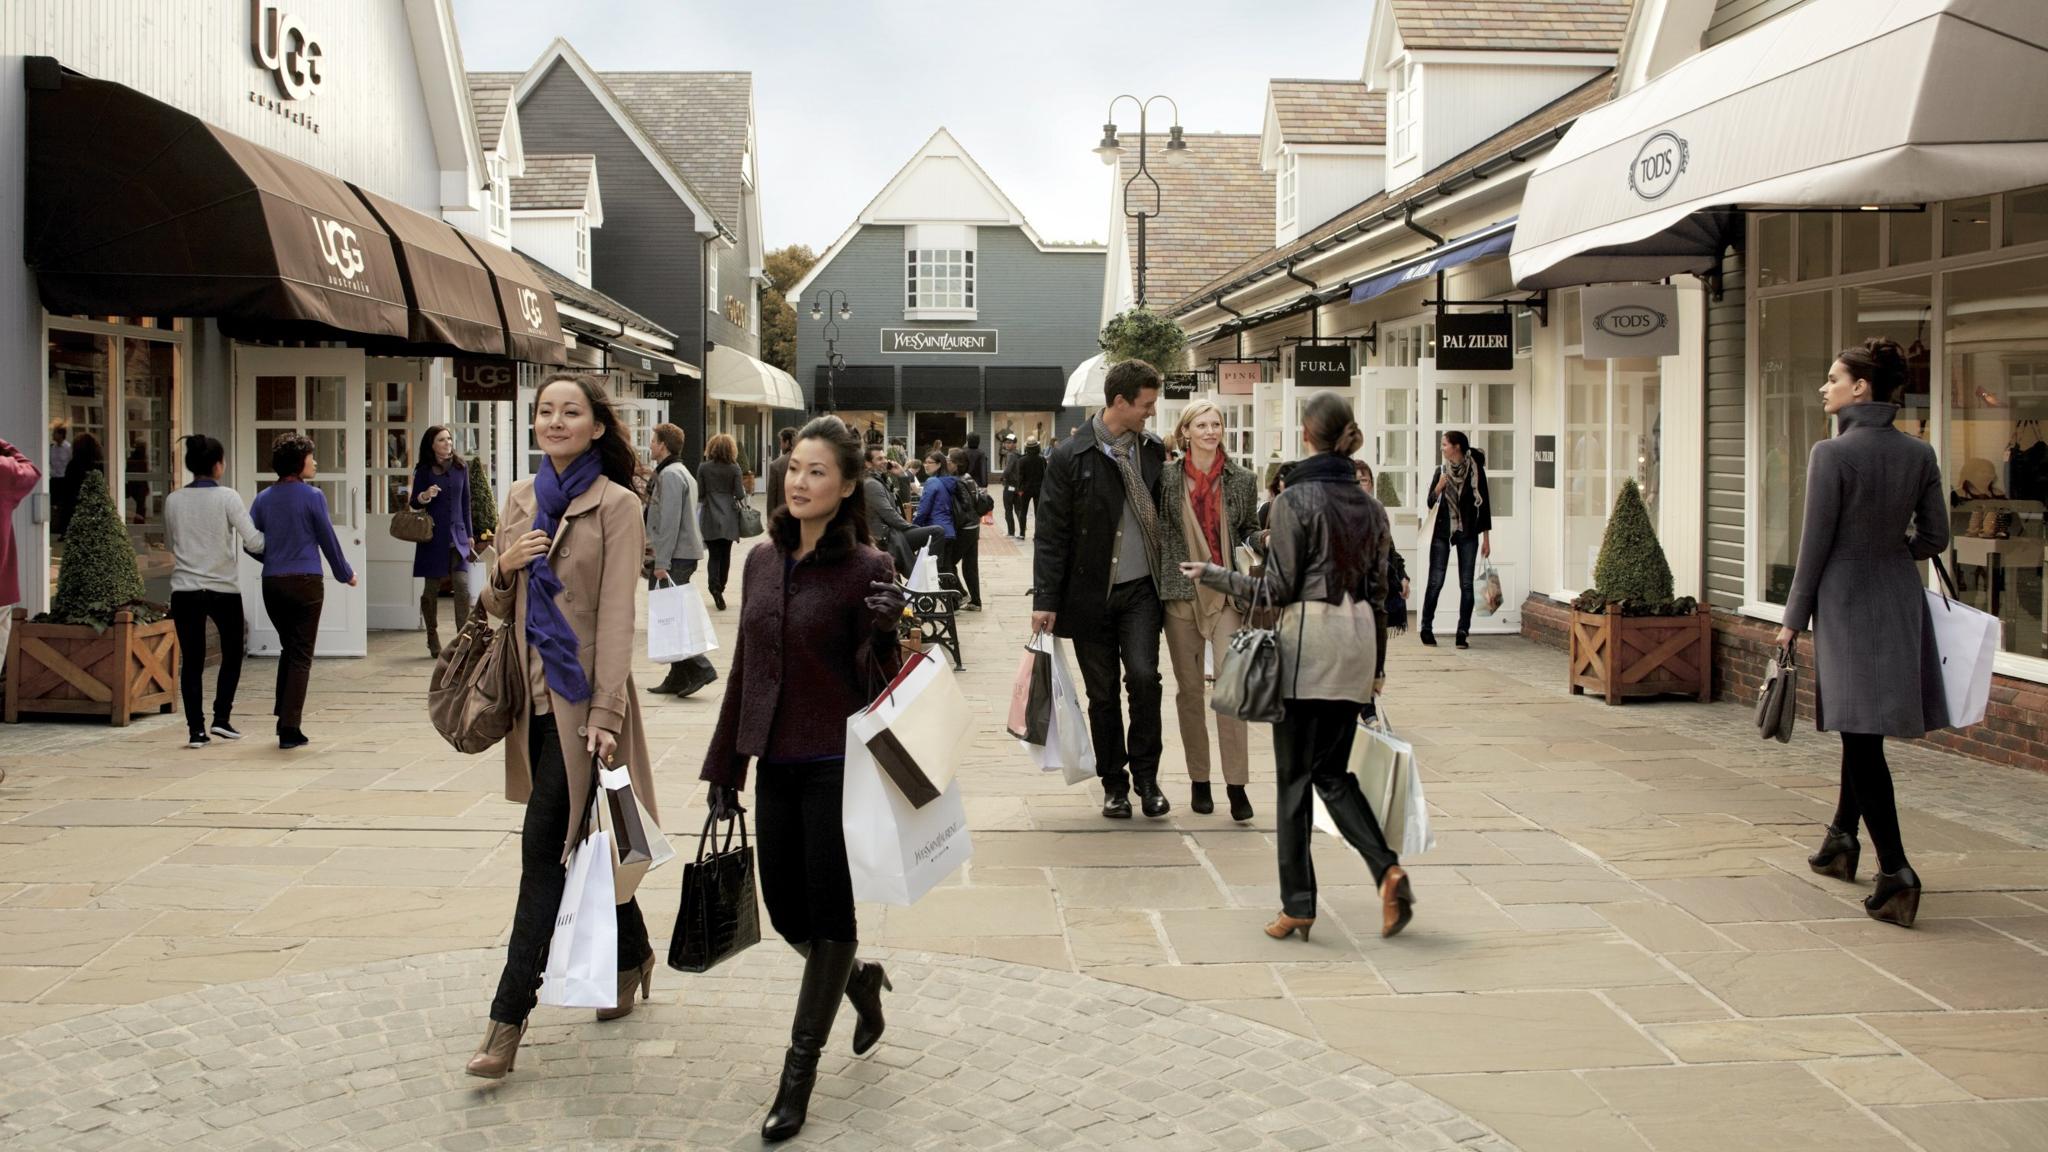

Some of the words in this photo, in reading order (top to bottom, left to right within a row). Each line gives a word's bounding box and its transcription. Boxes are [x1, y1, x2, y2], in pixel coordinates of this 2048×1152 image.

[251, 0, 326, 101] UGG
[1641, 150, 1672, 183] TOD'S
[312, 216, 364, 279] UGG
[517, 288, 542, 328] UGG
[1612, 315, 1650, 327] TOD'S
[1443, 335, 1466, 348] PAL
[1469, 335, 1508, 348] ZILERI
[463, 365, 511, 388] UGG
[1300, 361, 1345, 371] FURLA
